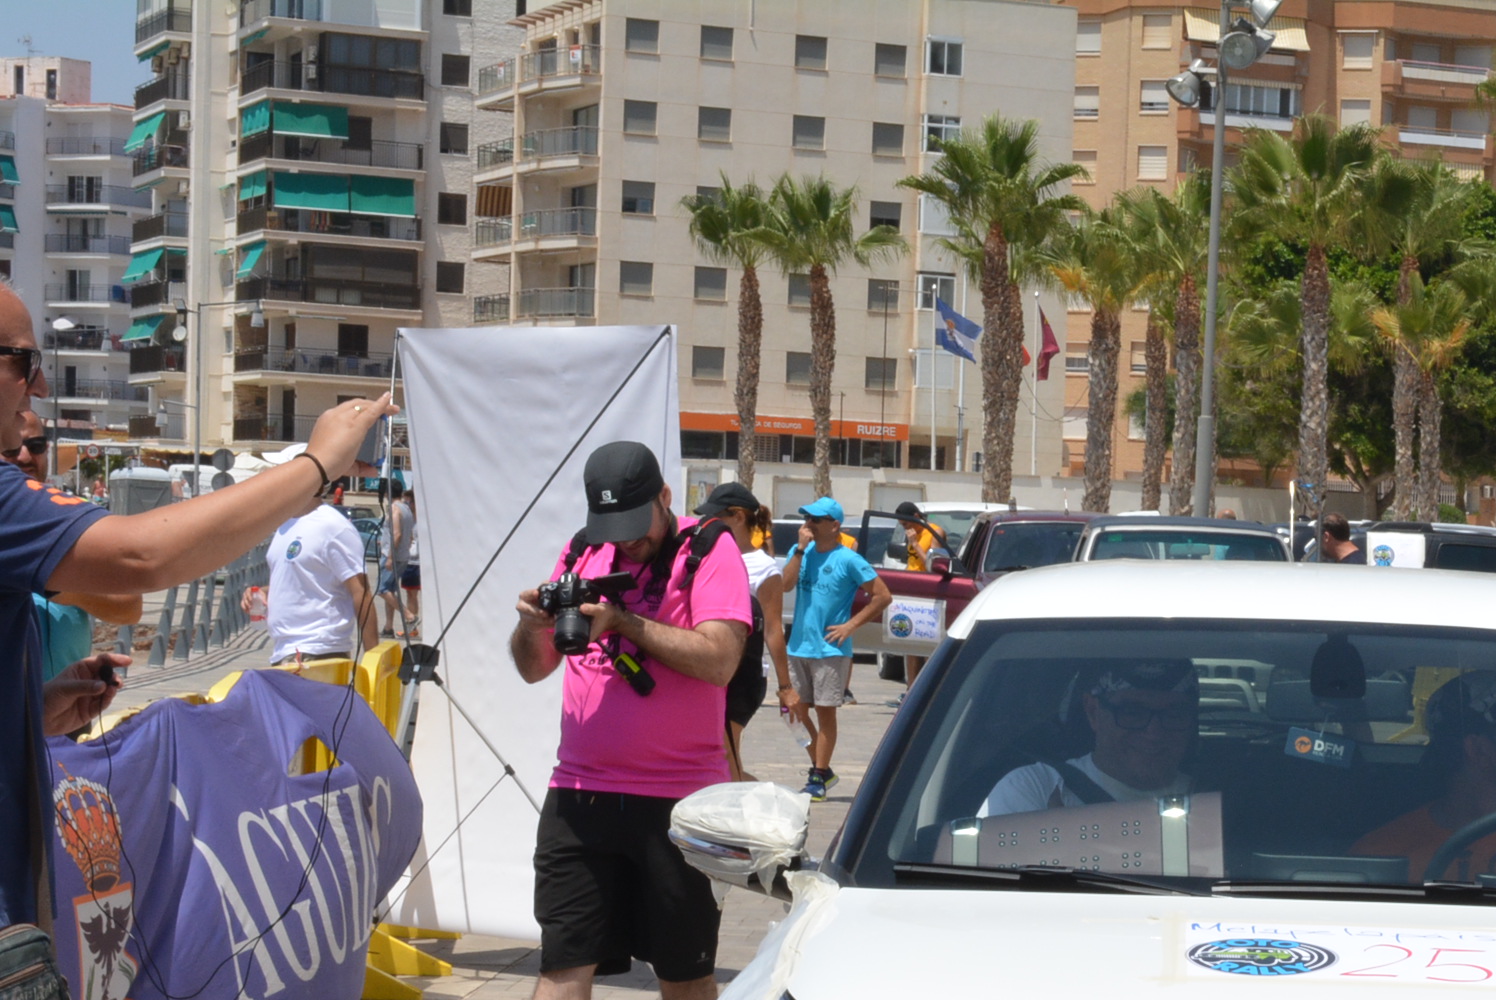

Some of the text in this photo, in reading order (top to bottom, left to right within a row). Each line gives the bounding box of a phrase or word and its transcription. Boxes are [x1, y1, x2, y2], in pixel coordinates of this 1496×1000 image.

[773, 421, 802, 430] SEGUROS
[857, 424, 897, 437] RUIZRE
[1314, 739, 1345, 756] DFM
[1208, 937, 1301, 950] FOTO
[1210, 961, 1312, 977] RALLY
[1339, 943, 1493, 983] 25
